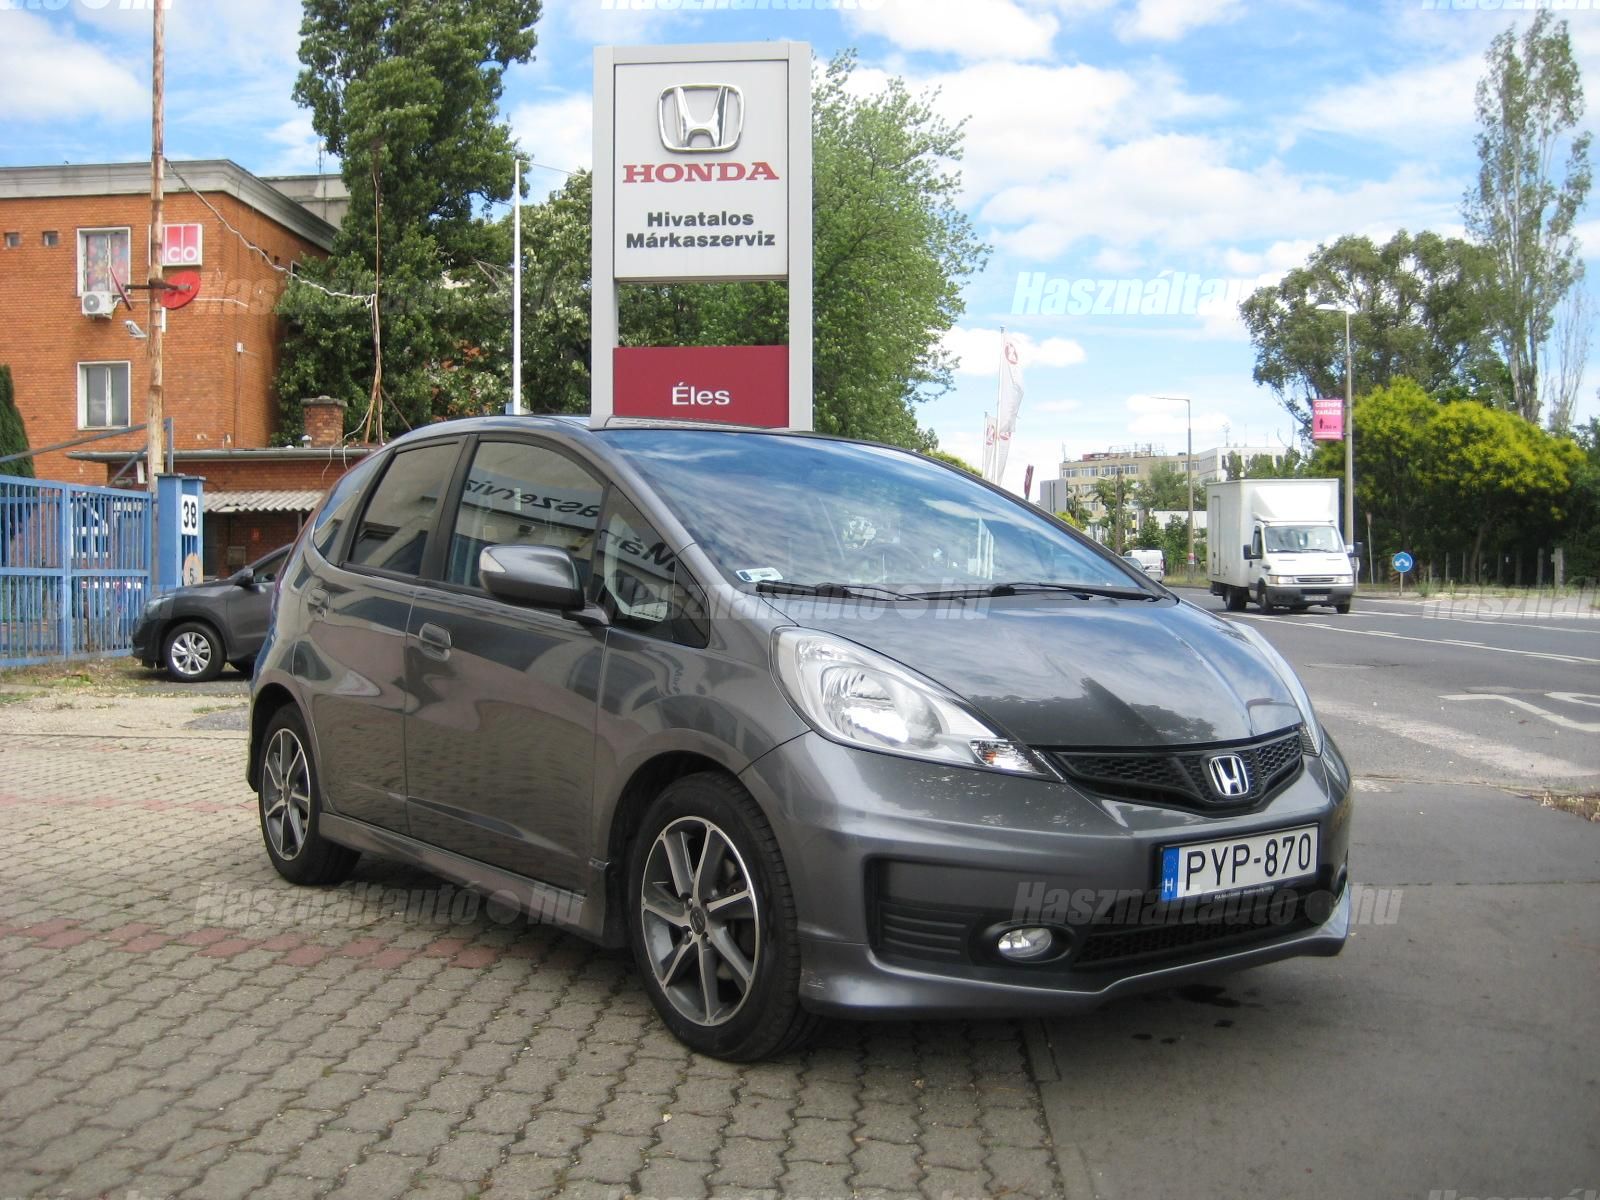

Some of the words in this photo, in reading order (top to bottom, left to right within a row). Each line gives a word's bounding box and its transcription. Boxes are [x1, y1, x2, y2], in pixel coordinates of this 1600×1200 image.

[623, 162, 779, 183] HONDA
[647, 211, 754, 227] Hivatalos
[626, 231, 775, 248] Márkaszerviz
[672, 382, 730, 405] Éles
[183, 501, 197, 529] 38
[1186, 833, 1311, 891] PYP-870
[1164, 878, 1174, 893] H
